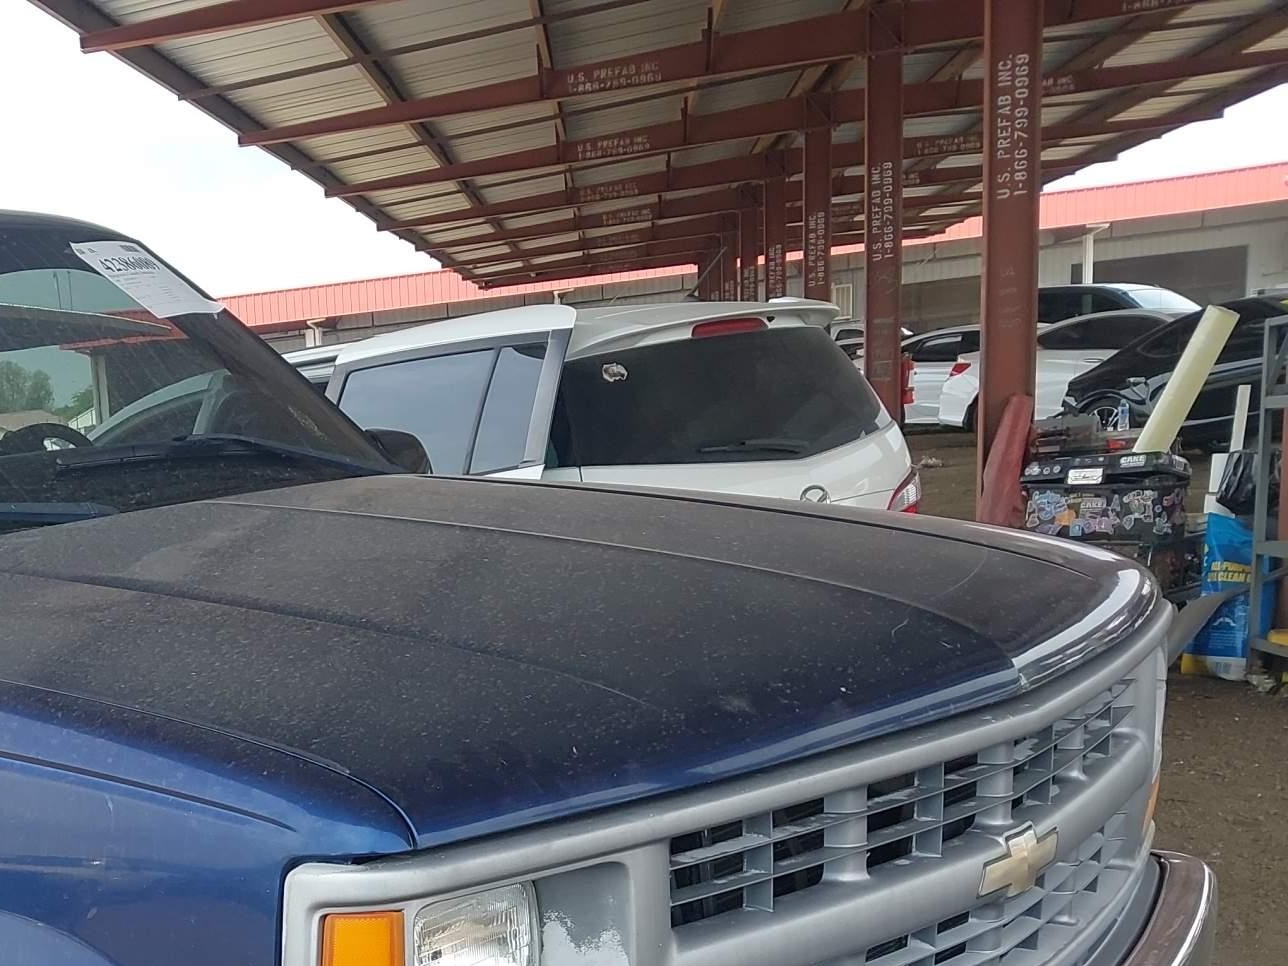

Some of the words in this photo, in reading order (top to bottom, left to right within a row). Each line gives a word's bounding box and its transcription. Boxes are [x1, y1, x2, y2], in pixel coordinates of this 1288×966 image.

[997, 54, 1013, 87] INC.
[996, 95, 1012, 159] PREFAB
[1013, 53, 1030, 196] 1-866-799-0969
[996, 167, 1012, 199] U.S.
[871, 190, 882, 234] PREFAB
[872, 238, 883, 261] U.S.
